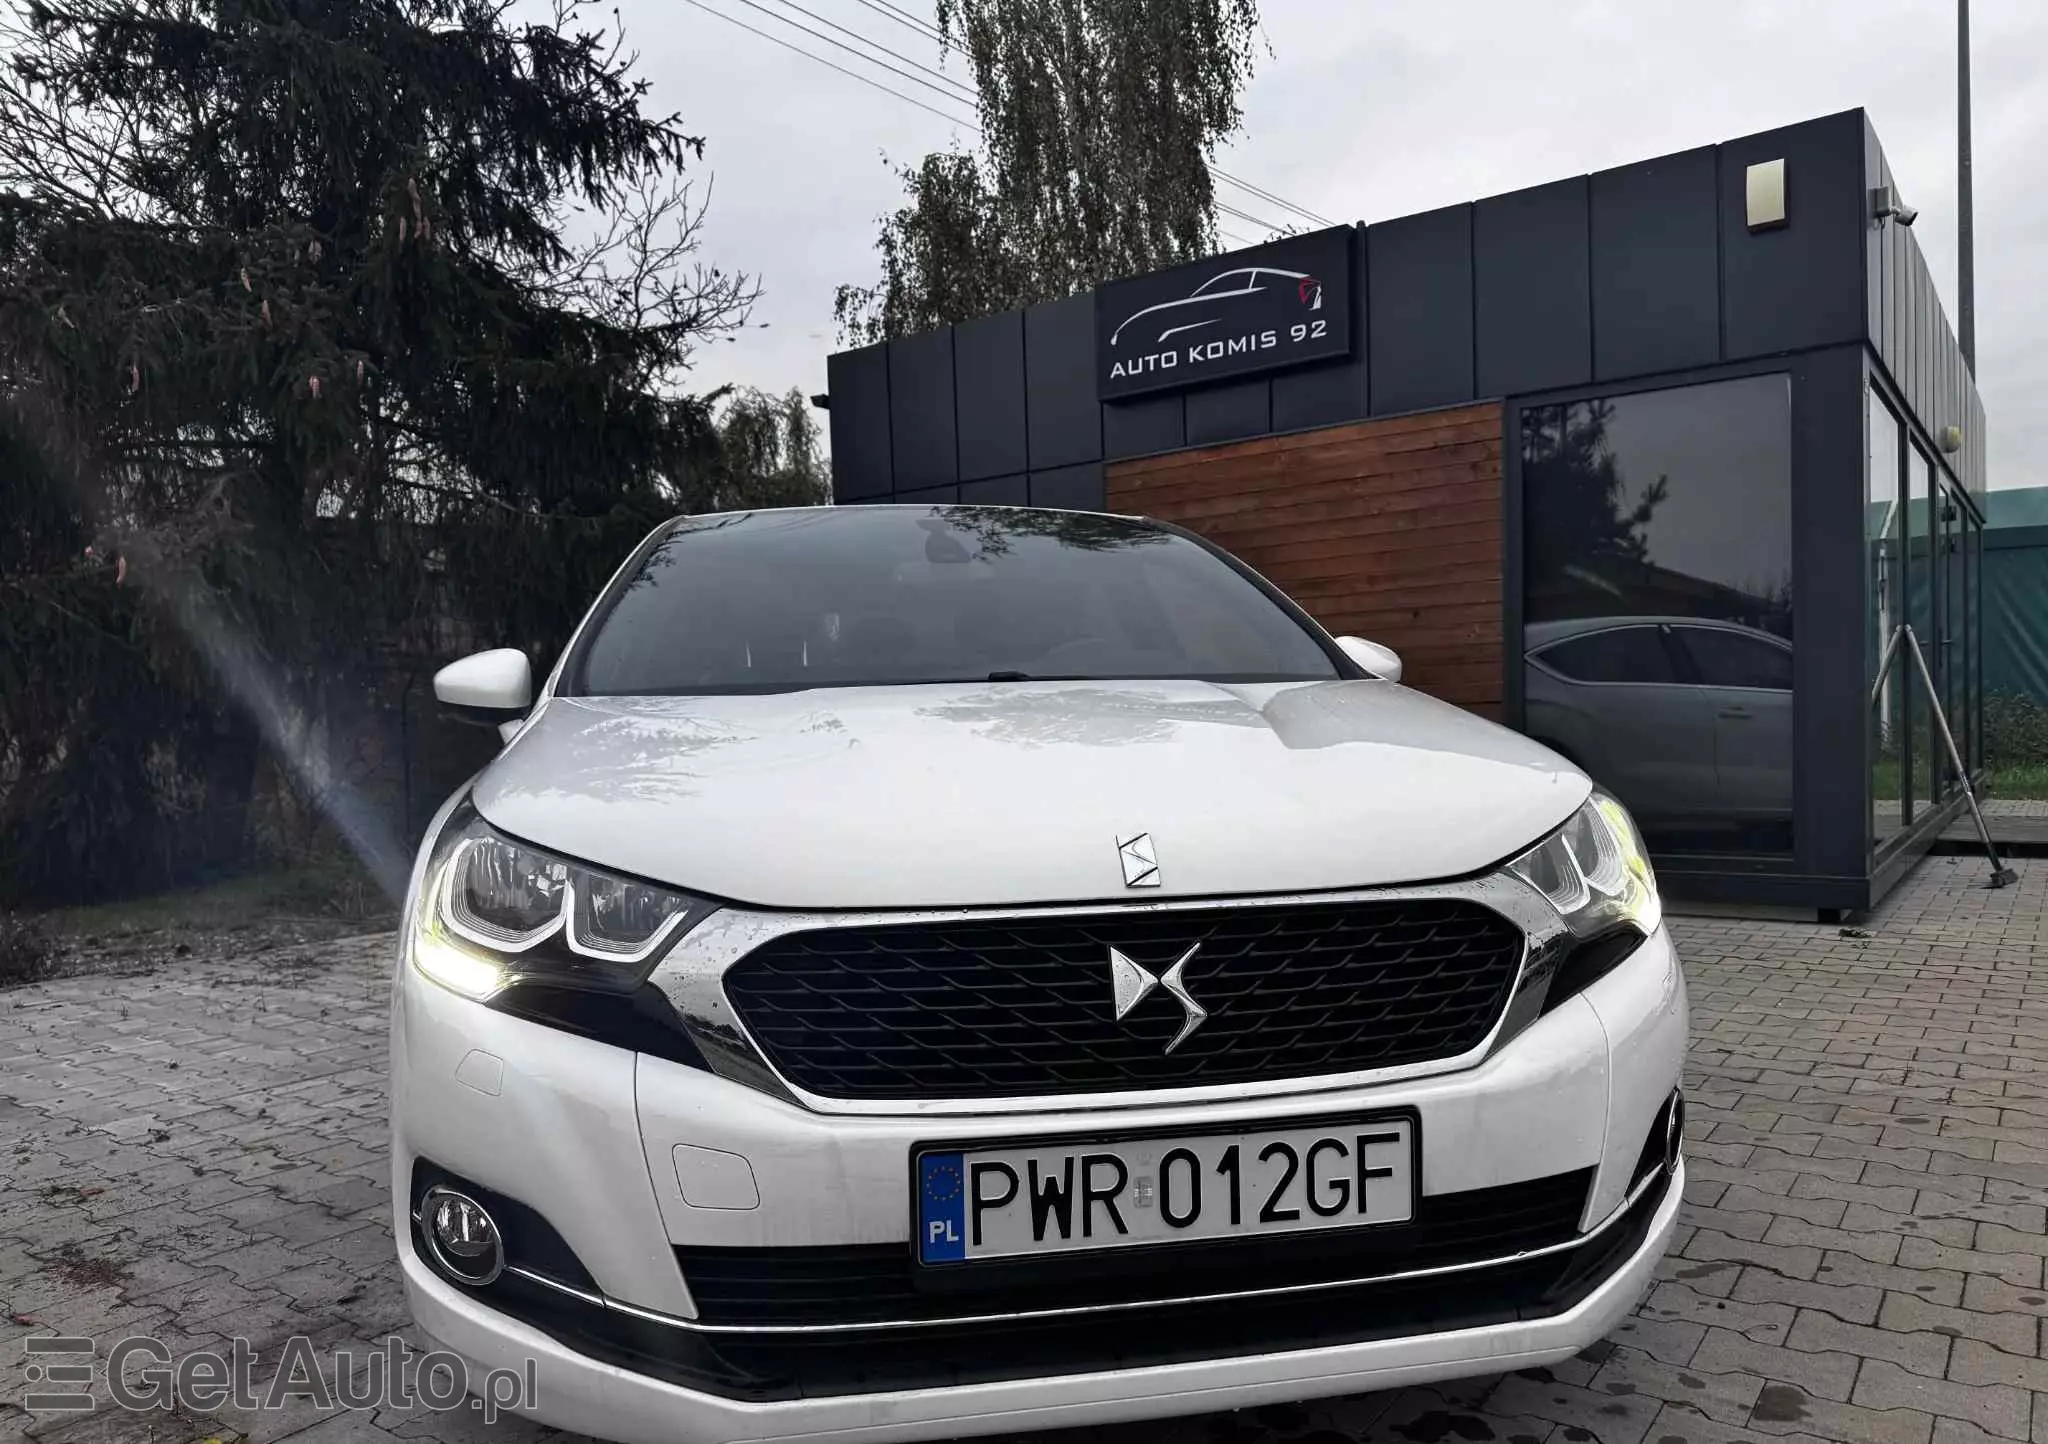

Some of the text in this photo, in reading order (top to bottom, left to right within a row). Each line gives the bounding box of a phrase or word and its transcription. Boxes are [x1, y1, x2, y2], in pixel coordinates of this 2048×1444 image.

[1110, 319, 1328, 379] AUTO KOMIS 92
[970, 1131, 1401, 1246] PWR 012GF
[929, 1219, 960, 1244] PL
